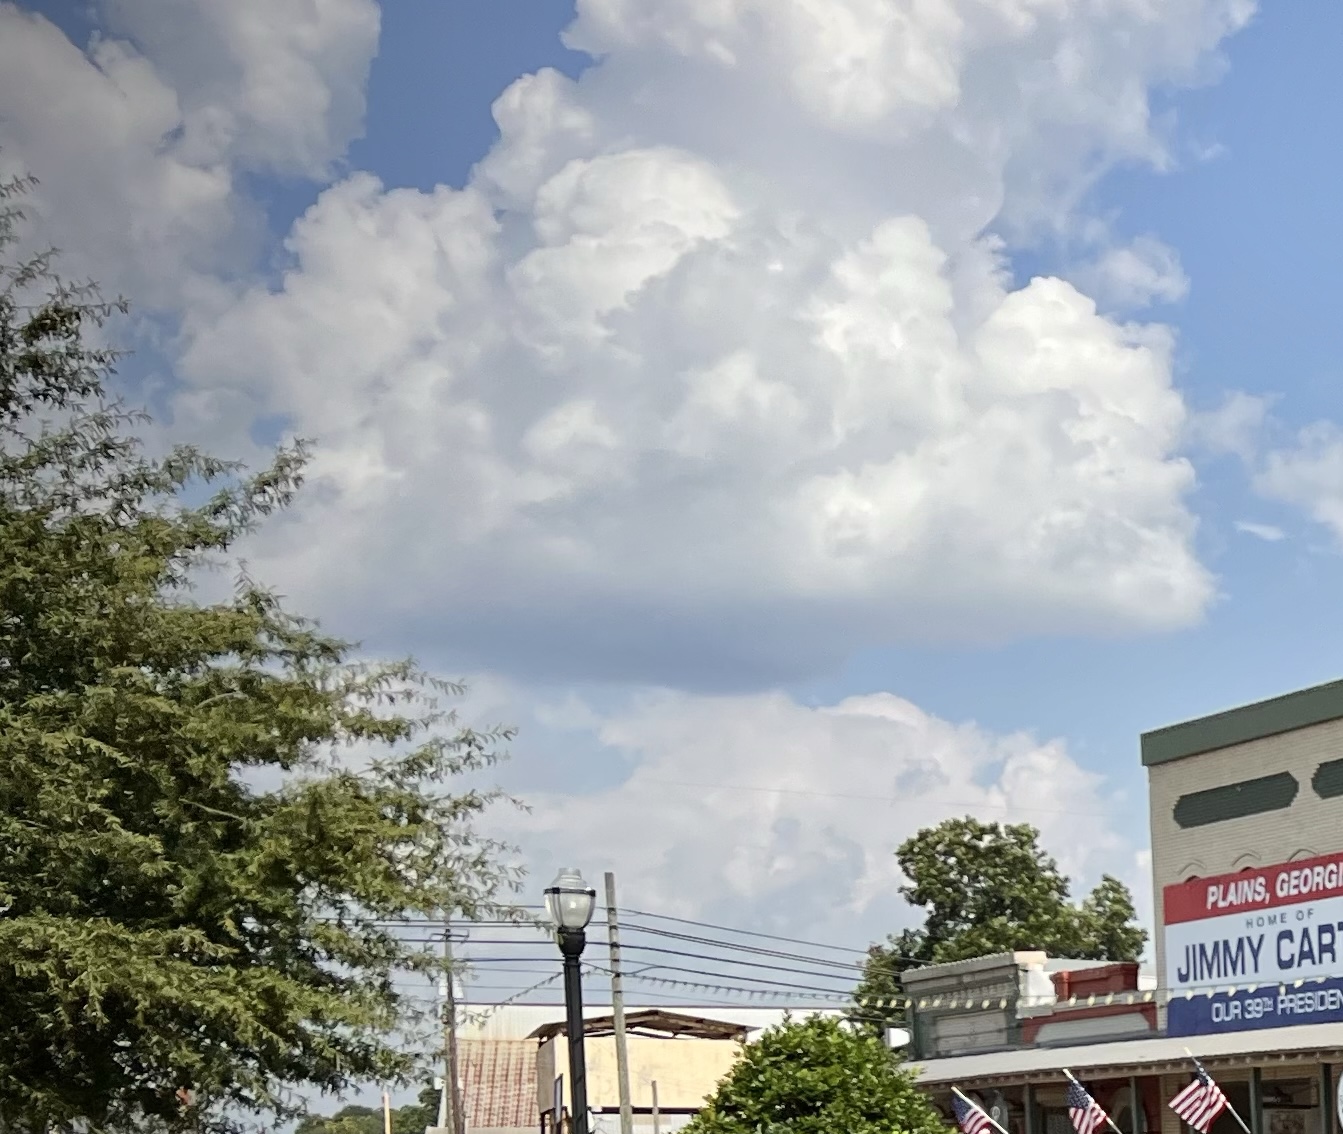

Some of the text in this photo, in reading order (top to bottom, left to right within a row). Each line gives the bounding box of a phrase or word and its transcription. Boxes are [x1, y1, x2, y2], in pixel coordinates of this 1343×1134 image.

[1206, 876, 1270, 909] PLAINS,
[1246, 908, 1315, 928] HOME OF
[1177, 933, 1265, 983] JIMMY
[1211, 1000, 1242, 1023] OUR
